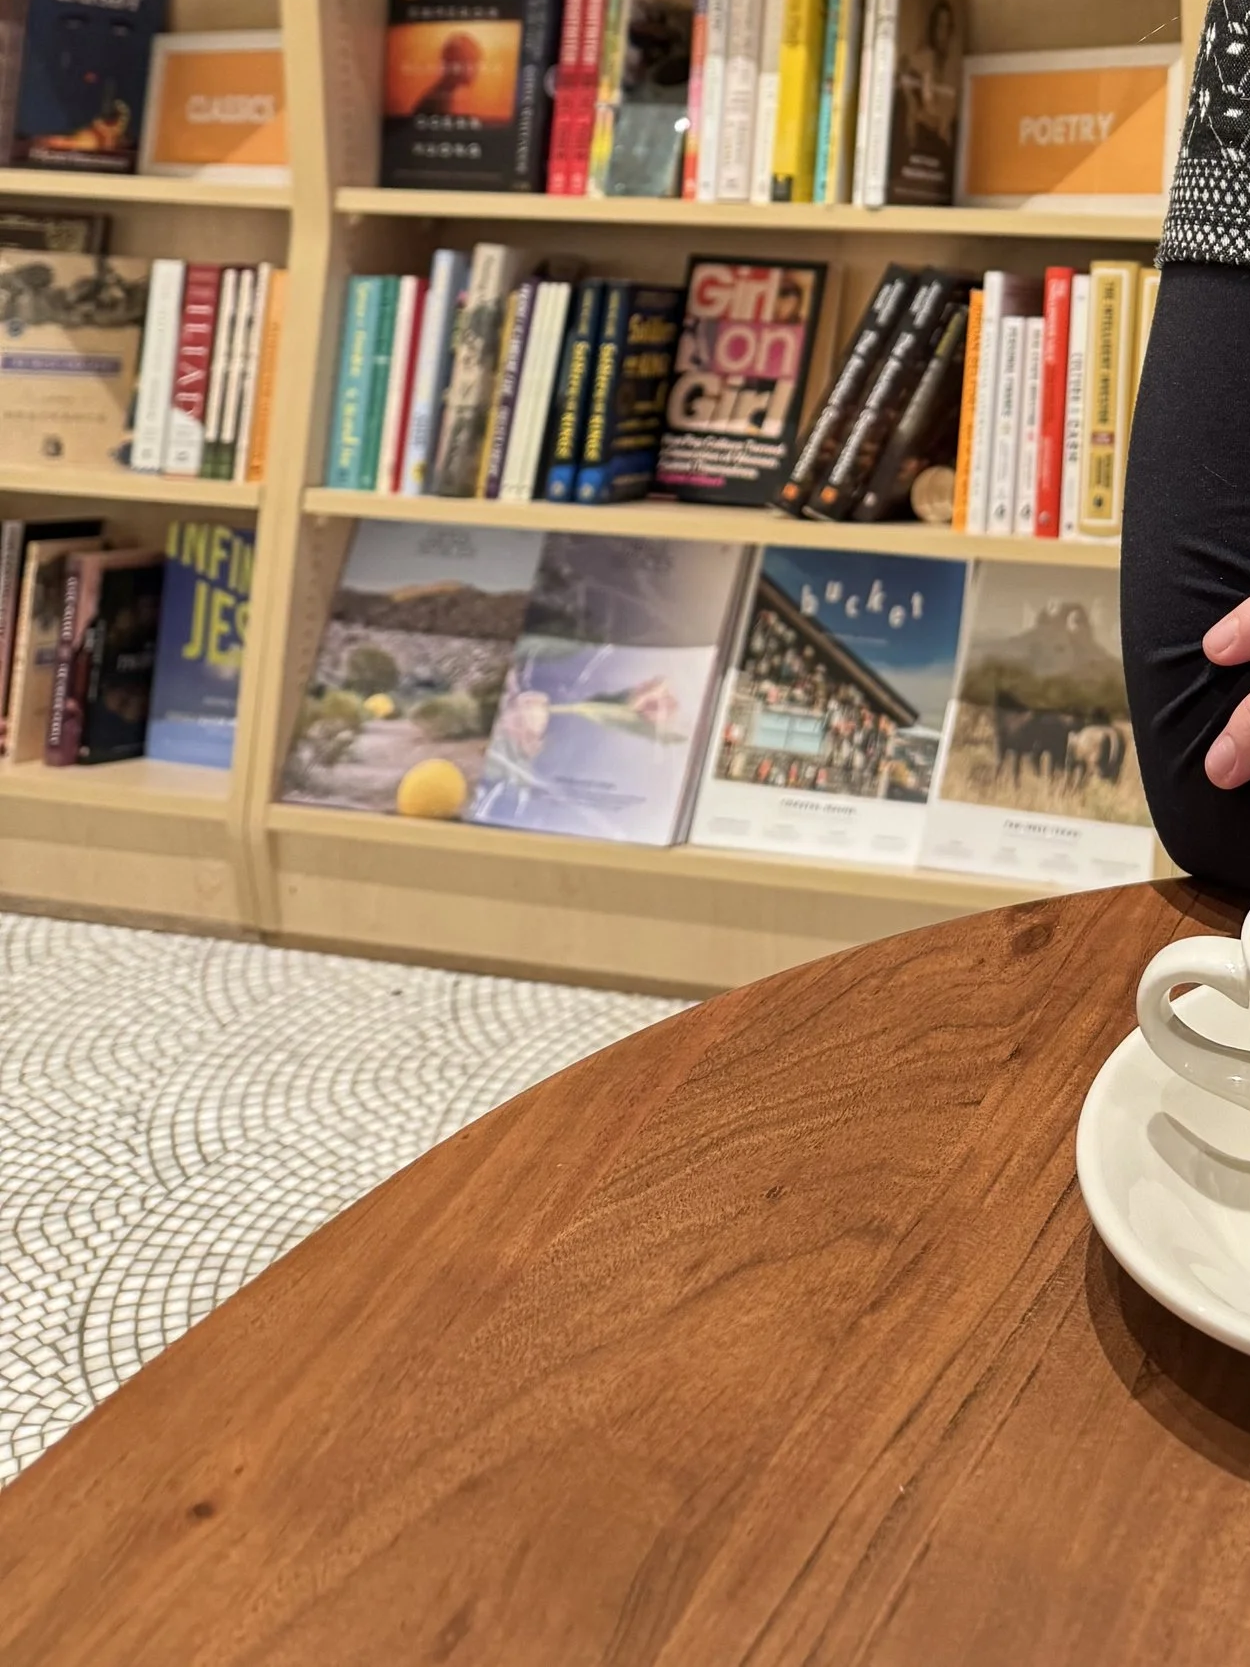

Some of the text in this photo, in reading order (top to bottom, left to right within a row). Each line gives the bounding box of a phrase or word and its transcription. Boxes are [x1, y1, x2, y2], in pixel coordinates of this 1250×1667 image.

[185, 94, 276, 124] CLASSICS
[1018, 111, 1116, 147] POETRY
[688, 262, 783, 322] Girl
[714, 324, 799, 376] on
[1098, 281, 1115, 425] THE INTELLIGENT INVESTOR
[665, 369, 795, 438] Girl
[181, 579, 250, 667] JES
[801, 579, 924, 629] bucket
